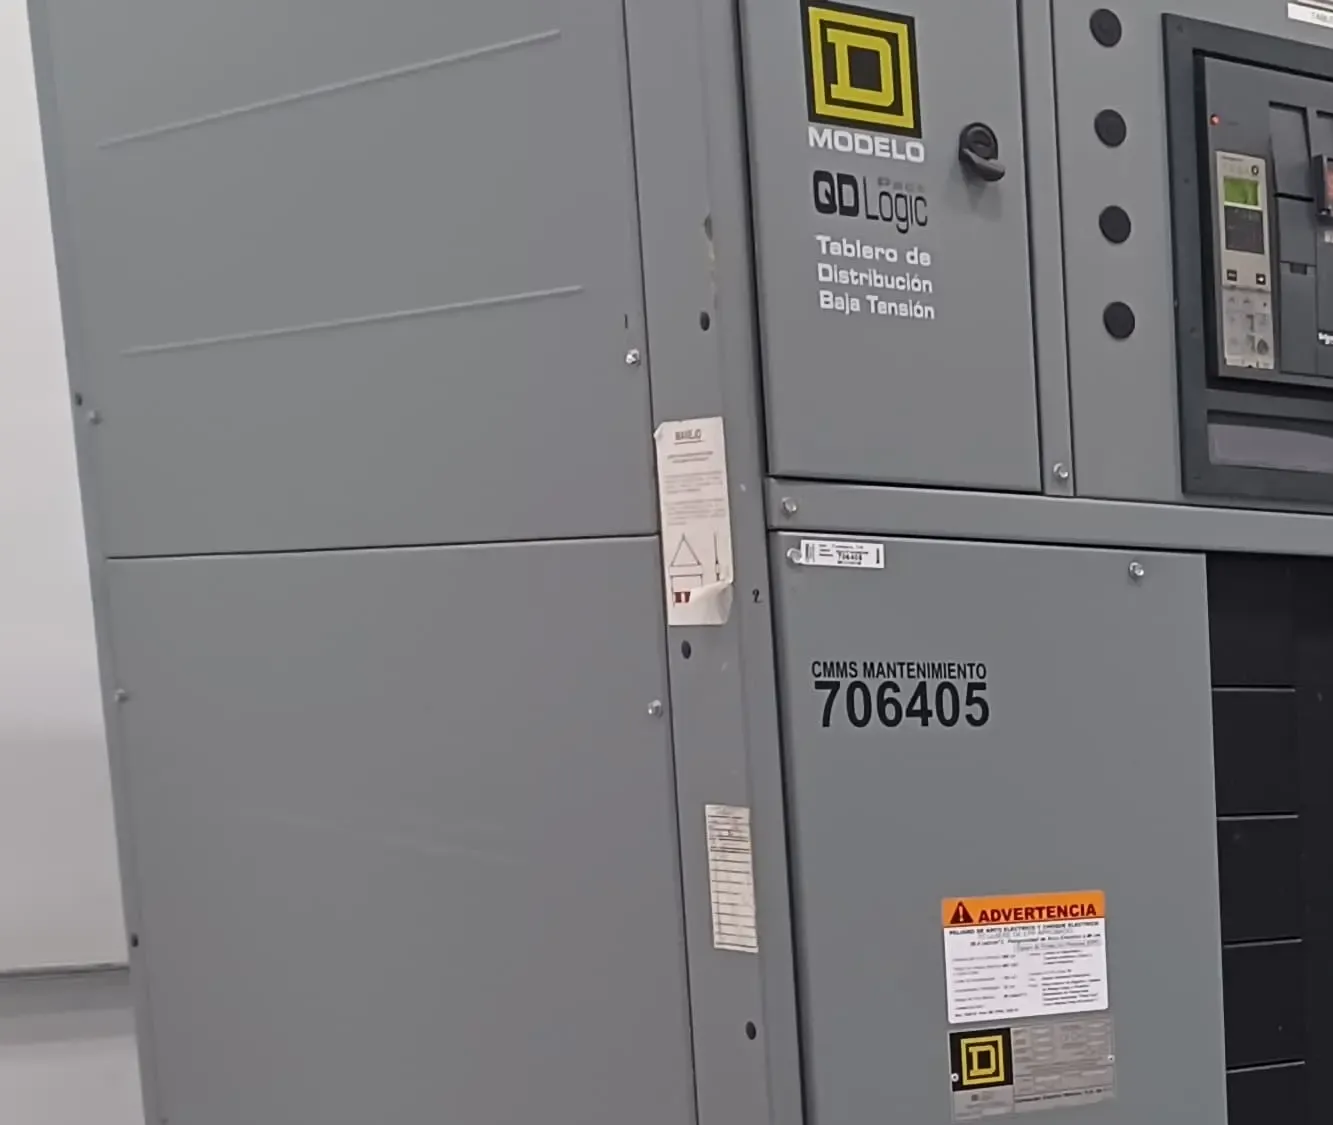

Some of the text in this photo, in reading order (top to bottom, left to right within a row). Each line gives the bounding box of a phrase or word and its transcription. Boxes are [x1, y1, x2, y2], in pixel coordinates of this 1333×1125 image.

[808, 126, 925, 163] MODELO
[816, 234, 932, 266] Tablero de
[817, 262, 934, 293] Distribución
[819, 289, 935, 320] Baja Tensión
[811, 660, 987, 680] CMMS MANTENIMIENTO
[814, 679, 990, 728] 706405
[978, 903, 1097, 923] ADVERTENCIA
